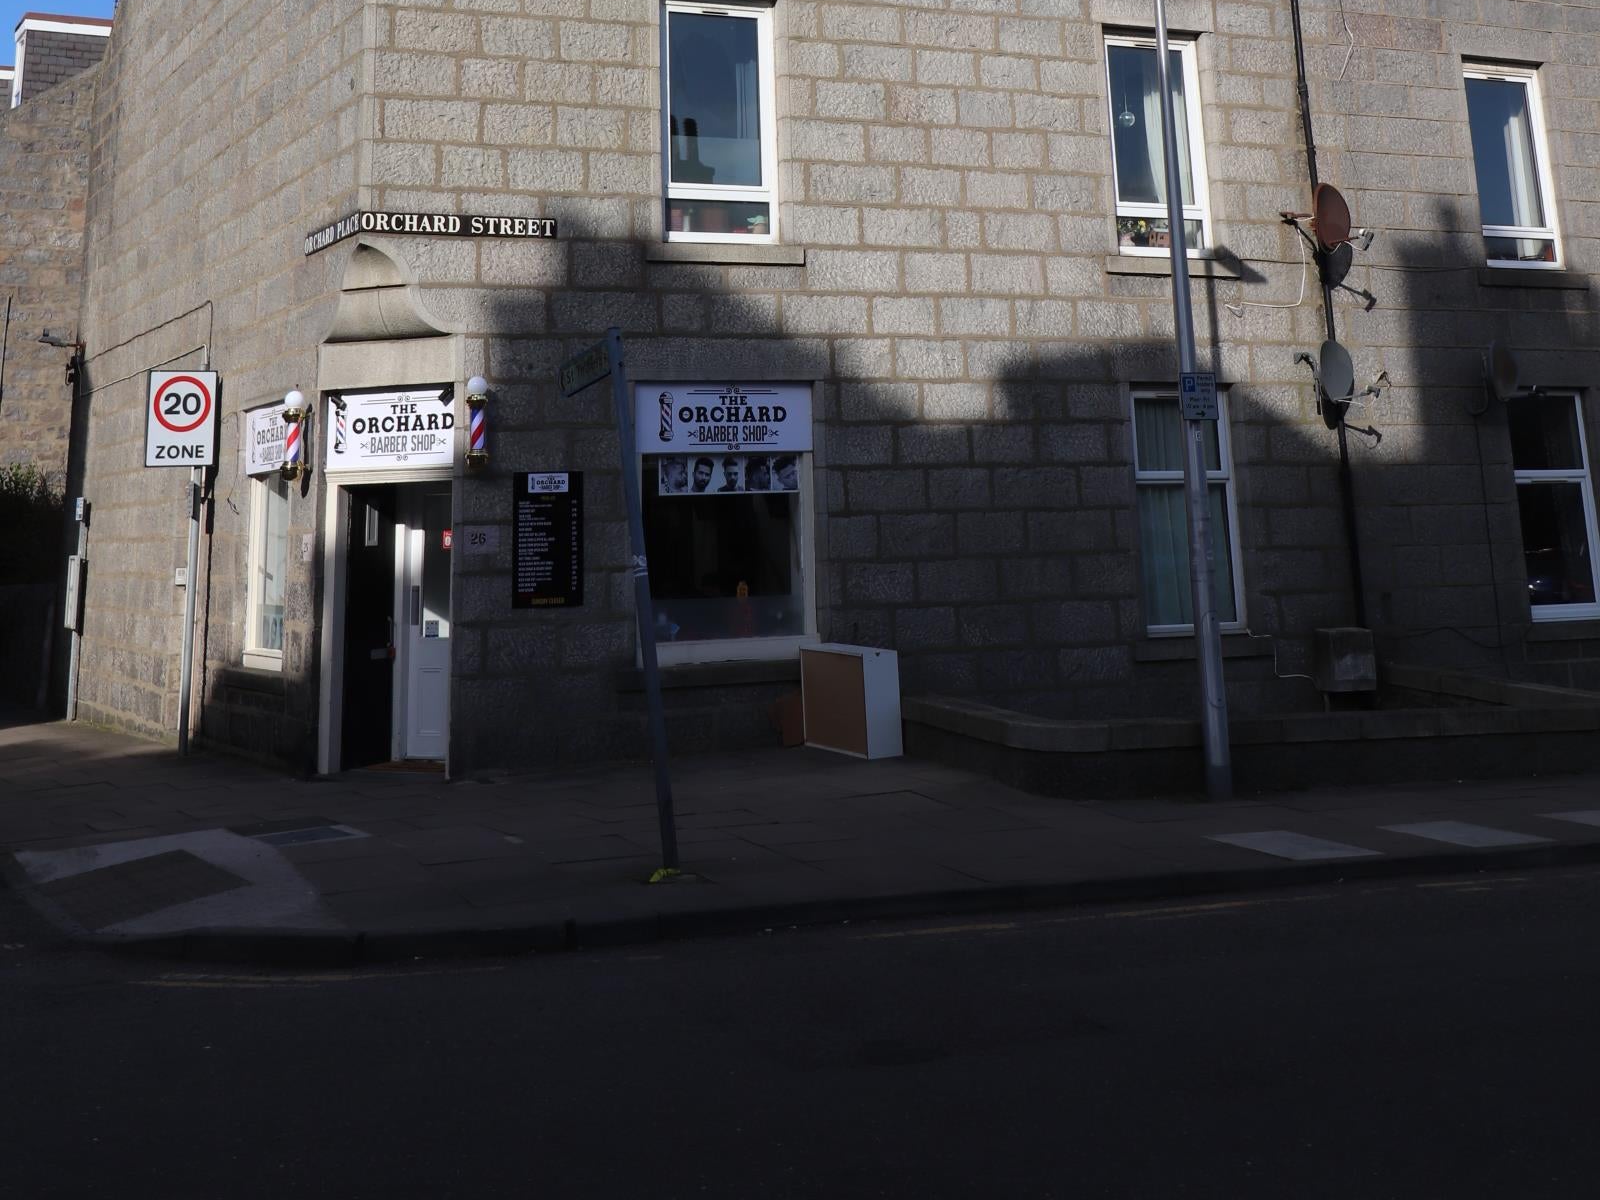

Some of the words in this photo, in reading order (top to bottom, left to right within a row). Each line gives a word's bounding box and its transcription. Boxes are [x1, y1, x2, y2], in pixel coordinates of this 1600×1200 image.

[304, 226, 335, 253] ORCHARD
[336, 213, 359, 237] PLACE
[361, 212, 461, 233] ORCHARD
[471, 217, 555, 237] STREET
[164, 392, 201, 415] 20
[719, 395, 748, 405] THE
[391, 404, 417, 414] THE
[679, 406, 787, 423] ORCHARD
[269, 416, 278, 427] THE
[352, 413, 454, 434] ORCHARD
[699, 426, 738, 442] BARBER
[742, 425, 768, 442] SHOP
[155, 445, 205, 459] ZONE
[370, 435, 407, 454] BARBER
[411, 434, 436, 452] SHOP
[471, 532, 486, 545] 26
